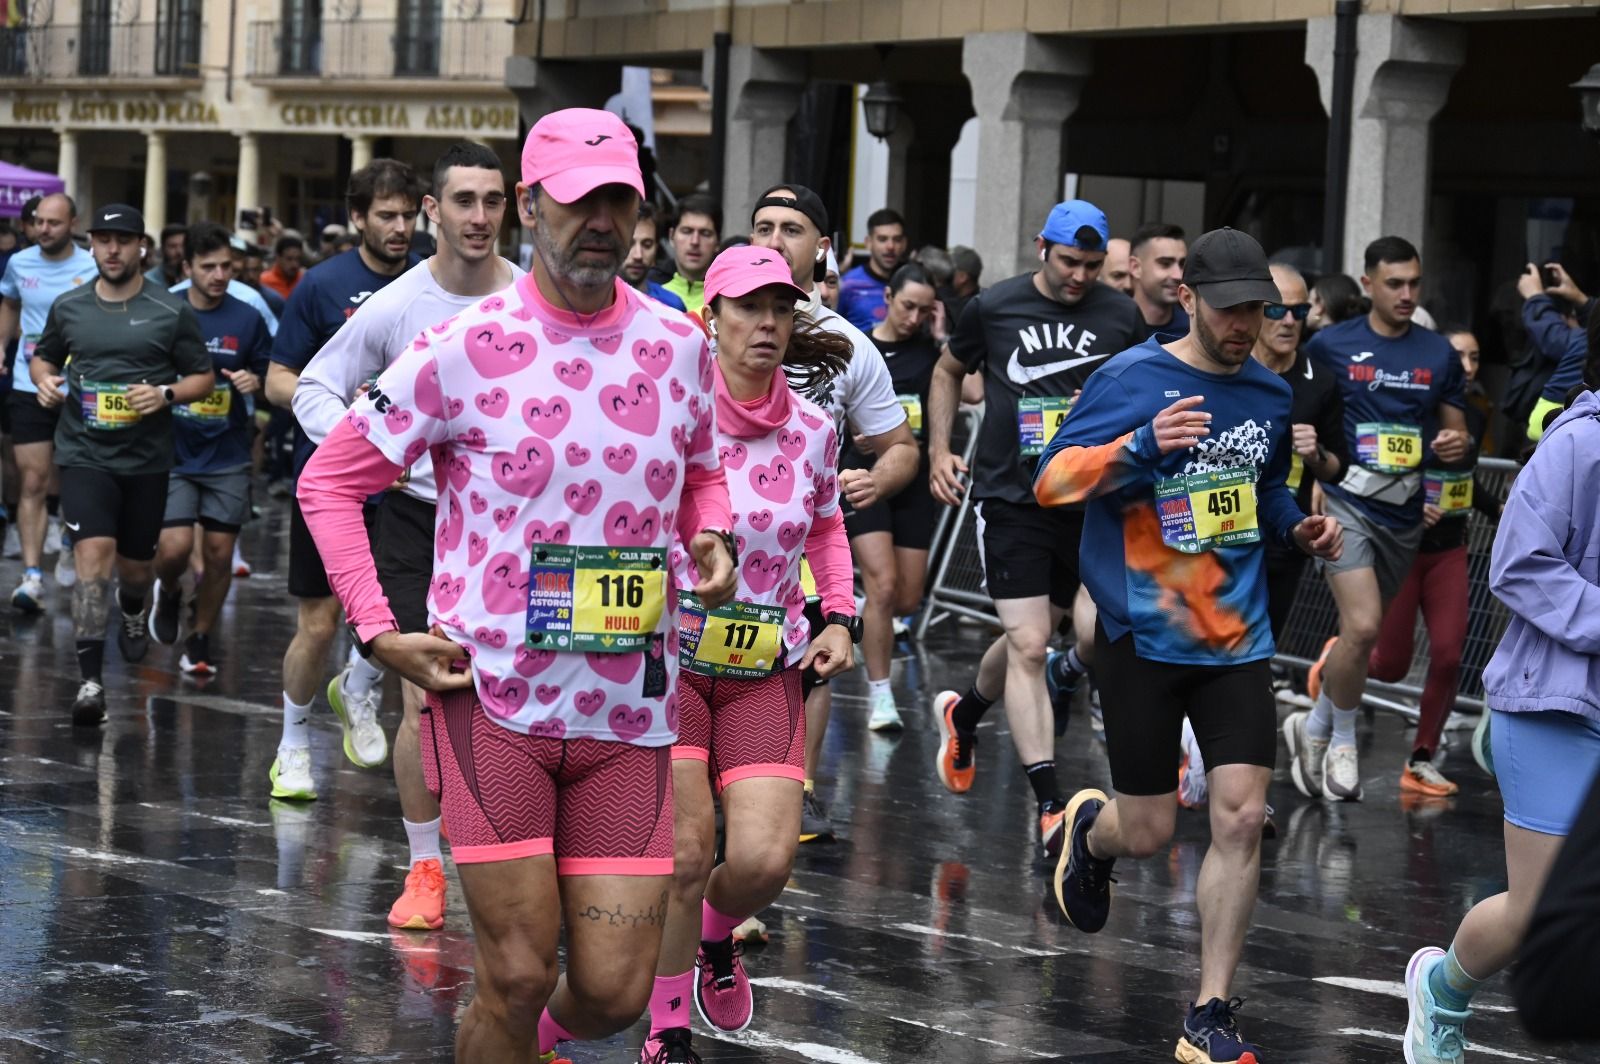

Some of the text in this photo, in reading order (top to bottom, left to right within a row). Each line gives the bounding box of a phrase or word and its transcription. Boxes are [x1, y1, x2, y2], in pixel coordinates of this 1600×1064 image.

[425, 105, 515, 129] ASADOR
[1018, 322, 1097, 357] NIKE
[1388, 437, 1412, 454] 526
[1208, 488, 1241, 517] 451
[1161, 512, 1183, 520] CIUDAD
[1162, 516, 1194, 527] ASTORGA
[1183, 522, 1193, 532] 26
[1221, 520, 1235, 532] RFB
[620, 552, 638, 561] CAJA
[534, 572, 571, 593] 10K
[530, 590, 560, 598] CIUDAD
[596, 574, 645, 608] 116
[529, 599, 572, 607] ASTORGA
[556, 608, 570, 619] 26
[744, 607, 759, 615] CAJA
[604, 616, 640, 631] HULIO
[724, 622, 760, 650] 117
[727, 668, 766, 678] CAJA RURAL
